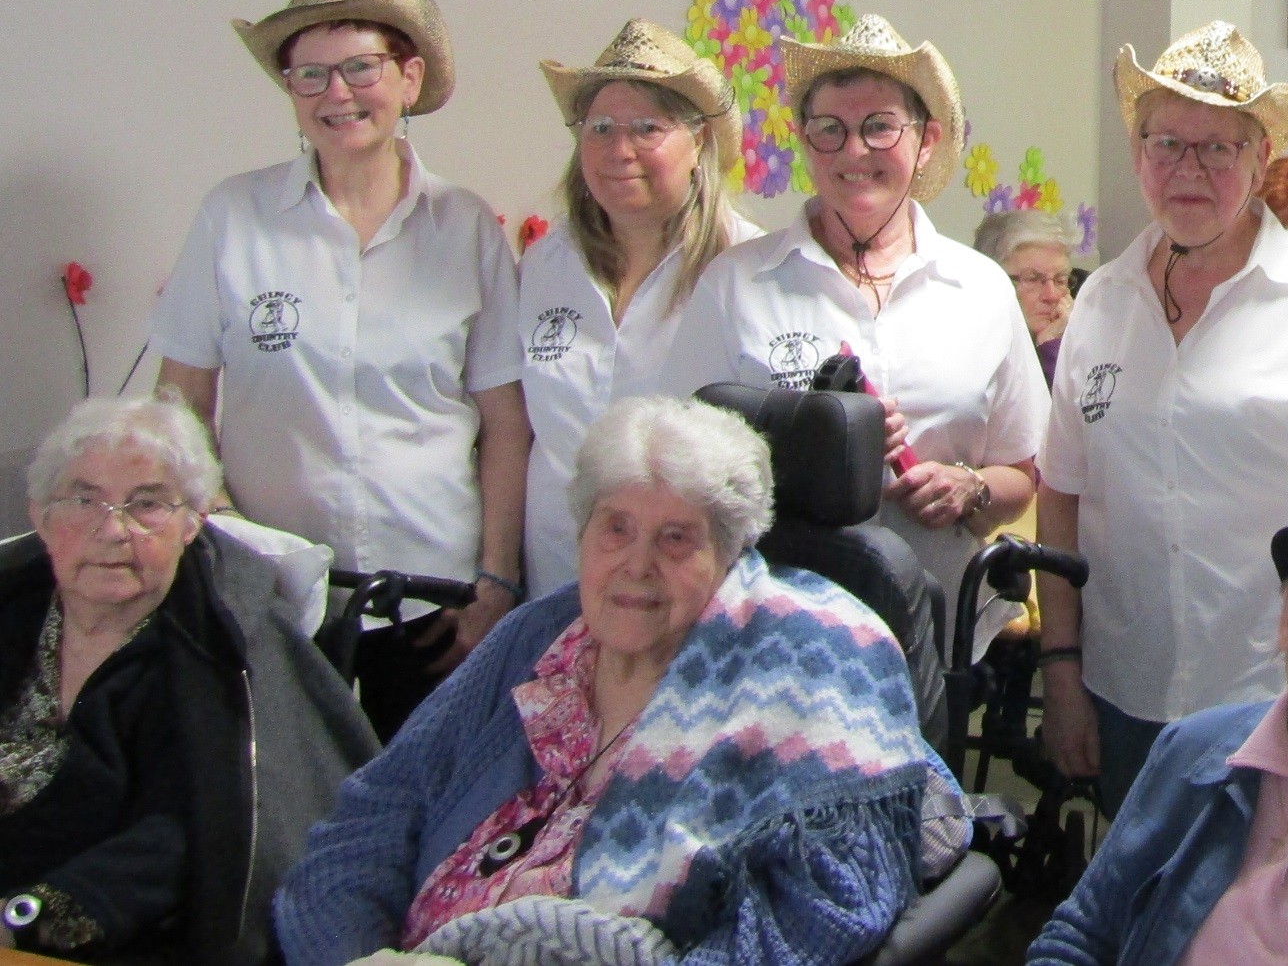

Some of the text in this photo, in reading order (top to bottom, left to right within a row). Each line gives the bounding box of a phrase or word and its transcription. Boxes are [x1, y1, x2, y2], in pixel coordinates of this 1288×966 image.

[251, 332, 298, 343] COUNTRY
[258, 340, 292, 352] CLUB
[532, 353, 562, 361] CLUB
